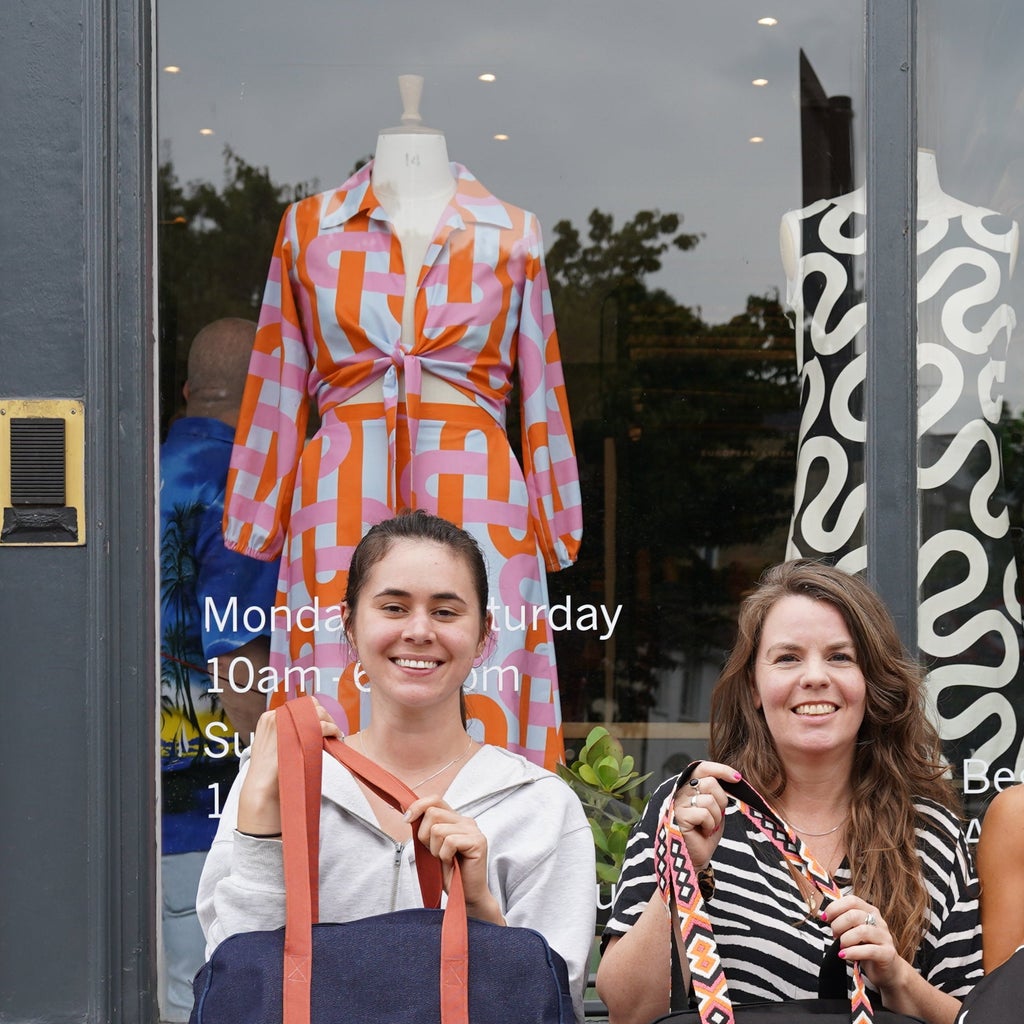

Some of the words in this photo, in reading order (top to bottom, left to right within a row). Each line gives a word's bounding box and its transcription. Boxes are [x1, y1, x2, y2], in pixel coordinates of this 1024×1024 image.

[204, 596, 345, 633] Monda
[487, 595, 623, 641] turday
[207, 656, 321, 694] 10am
